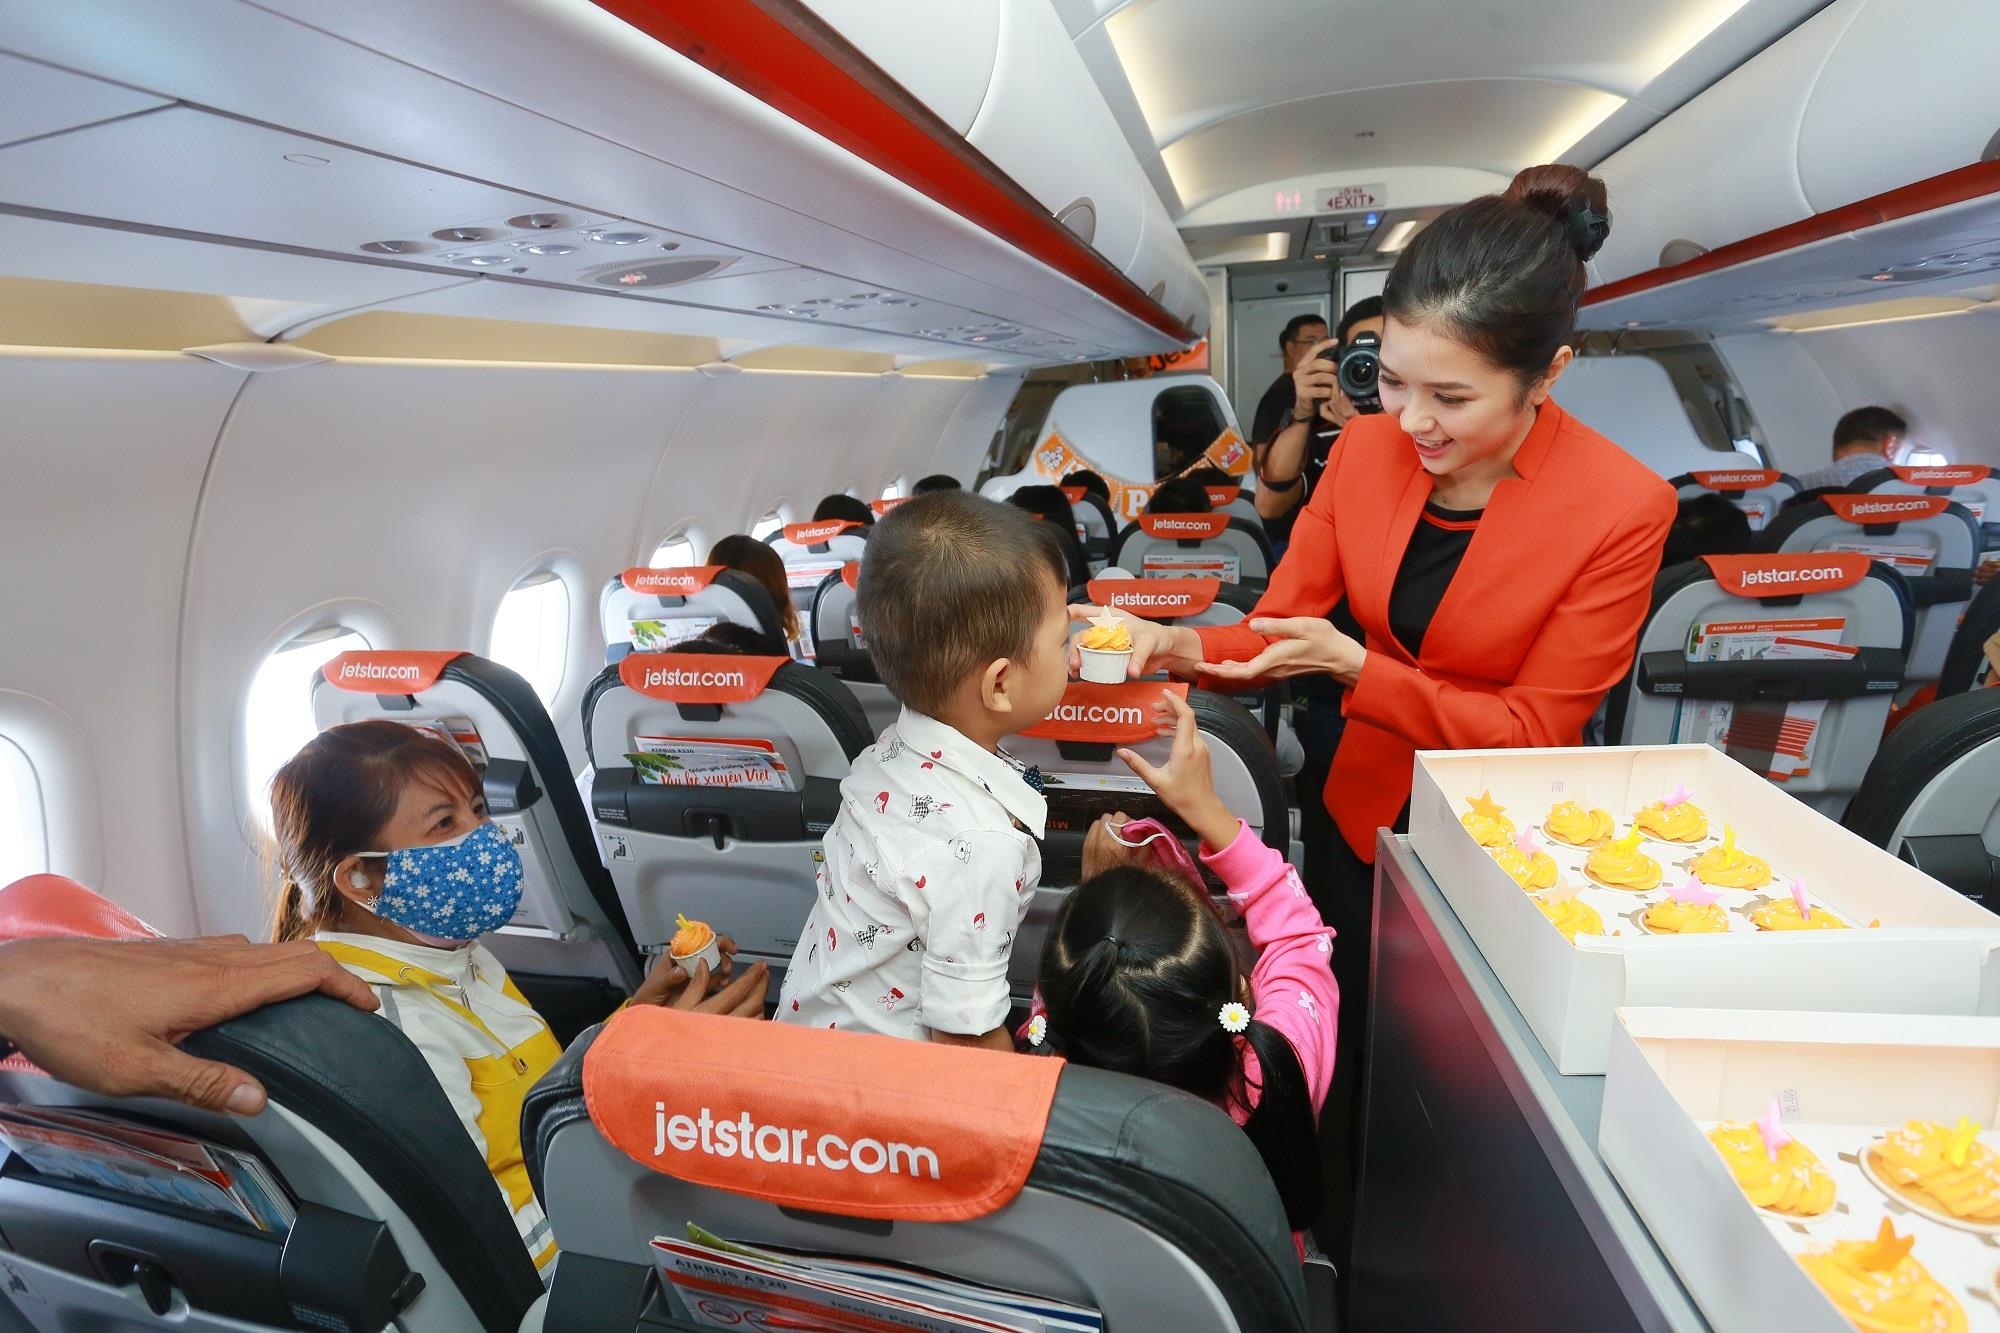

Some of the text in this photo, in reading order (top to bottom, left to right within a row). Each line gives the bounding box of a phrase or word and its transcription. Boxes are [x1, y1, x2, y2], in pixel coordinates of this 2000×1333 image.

[1335, 194, 1367, 208] EXIT
[1709, 473, 1765, 484] jetstar.com
[1910, 469, 1973, 480] jetstar.com
[1852, 499, 1930, 516] jetstar.com
[1153, 518, 1211, 531] jetstar.com
[635, 574, 695, 587] jetstar.com
[1741, 566, 1843, 588] jetstar.com
[1111, 592, 1192, 607] jetstar.com
[339, 661, 420, 680] jetstar.com
[643, 667, 744, 689] jetstar.com
[1043, 703, 1143, 725] tar.com
[654, 1101, 941, 1180] jetstar.com
[675, 1258, 739, 1280] AIRBUS
